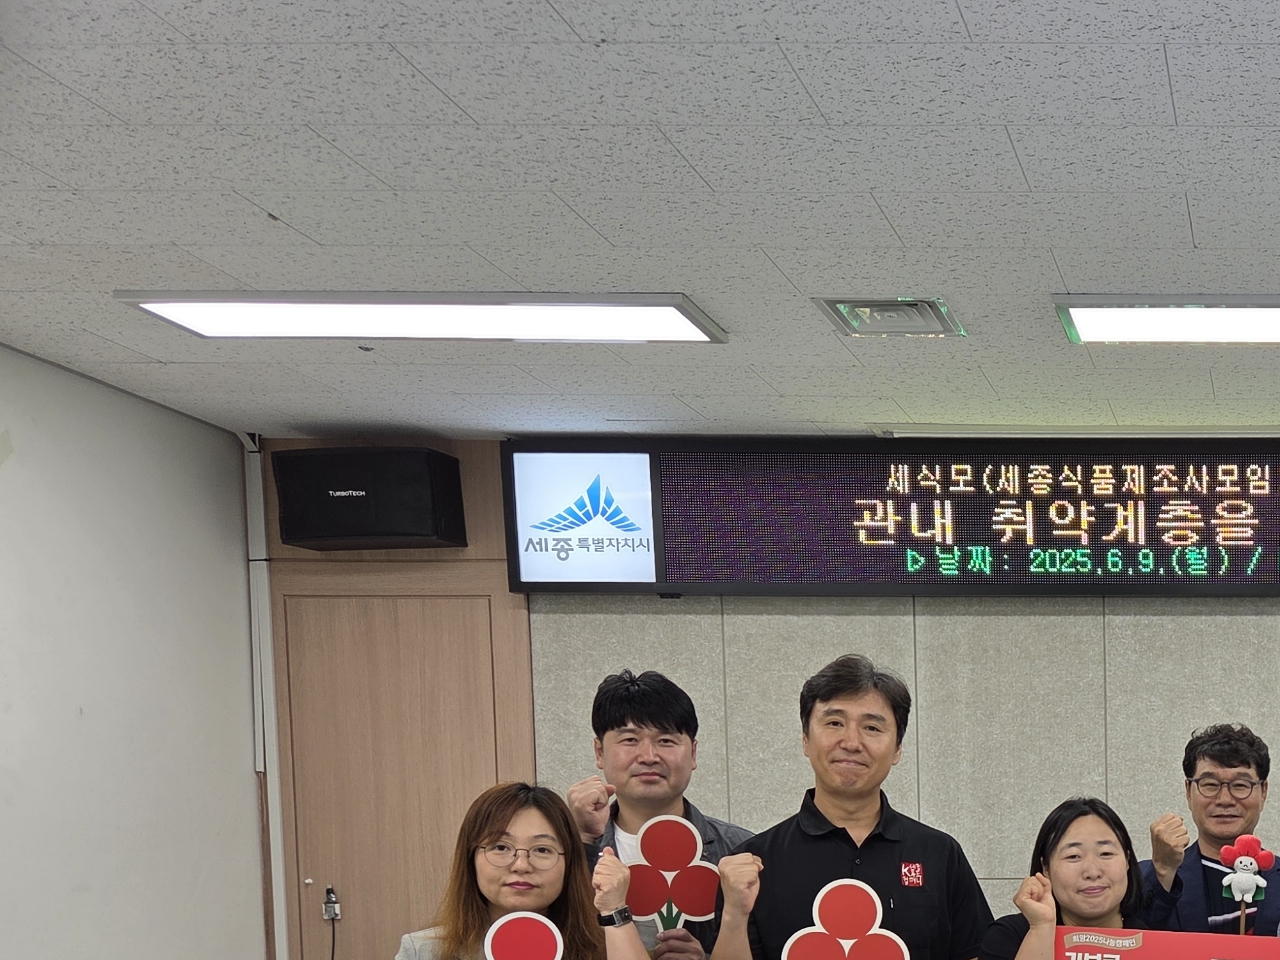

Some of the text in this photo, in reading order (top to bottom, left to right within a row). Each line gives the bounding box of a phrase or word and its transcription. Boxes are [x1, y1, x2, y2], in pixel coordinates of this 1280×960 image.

[853, 499, 954, 545] 관내
[992, 499, 1260, 545] 취약계층을
[1029, 545, 1230, 575] 2025.6.9.(월)
